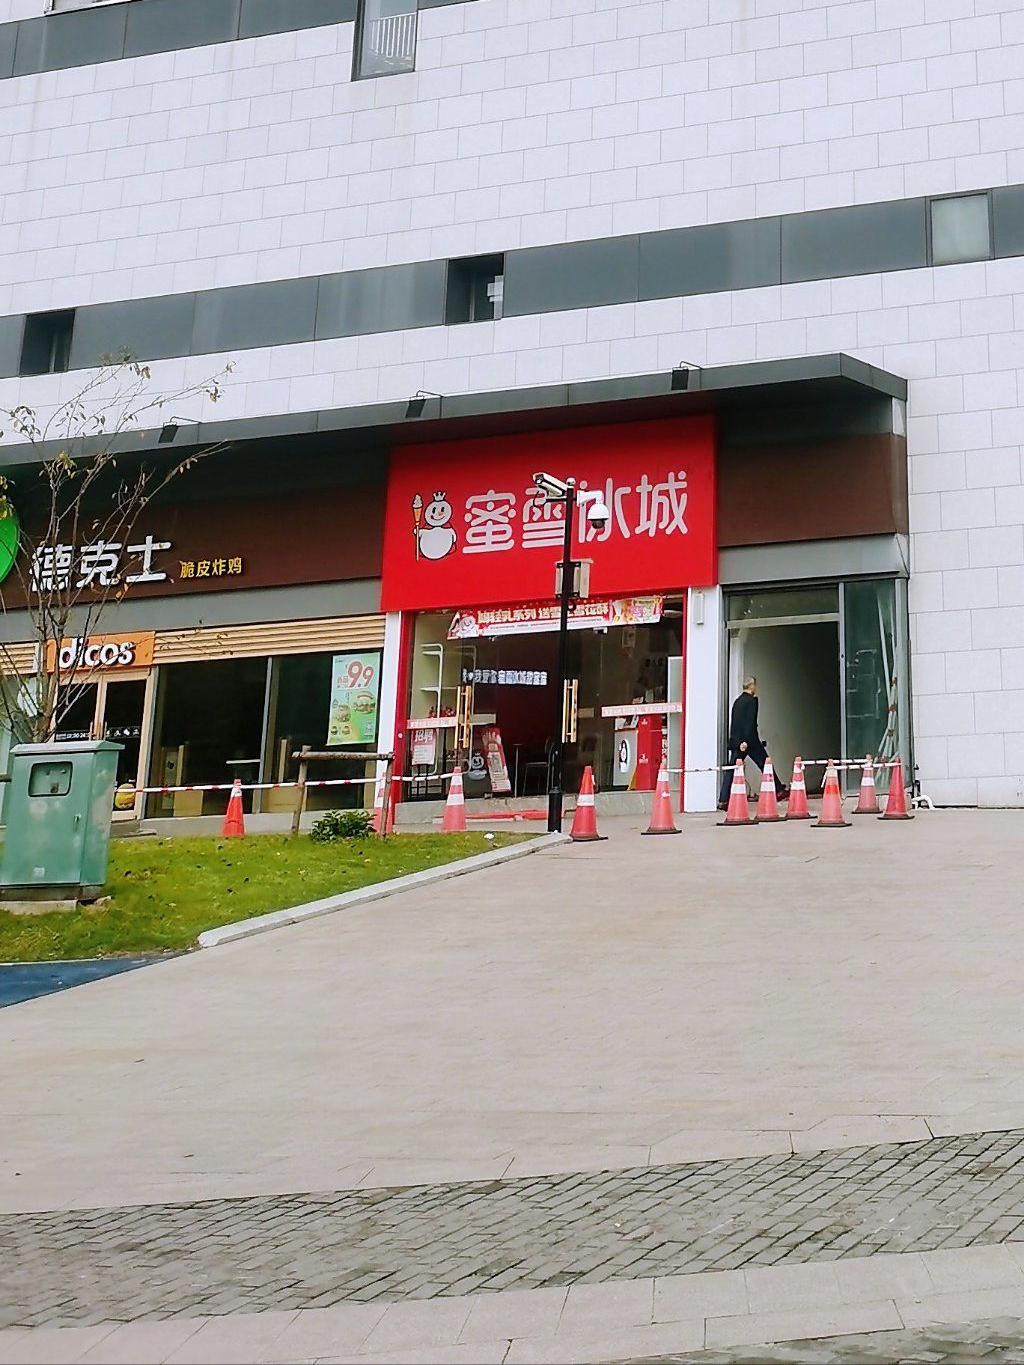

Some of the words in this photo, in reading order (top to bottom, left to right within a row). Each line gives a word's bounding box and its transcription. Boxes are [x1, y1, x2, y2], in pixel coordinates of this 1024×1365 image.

[462, 470, 688, 554] 蜜雪冰城
[28, 535, 172, 592] 德克士
[179, 556, 243, 579] 脆皮炸鸡
[59, 637, 136, 670] dicos
